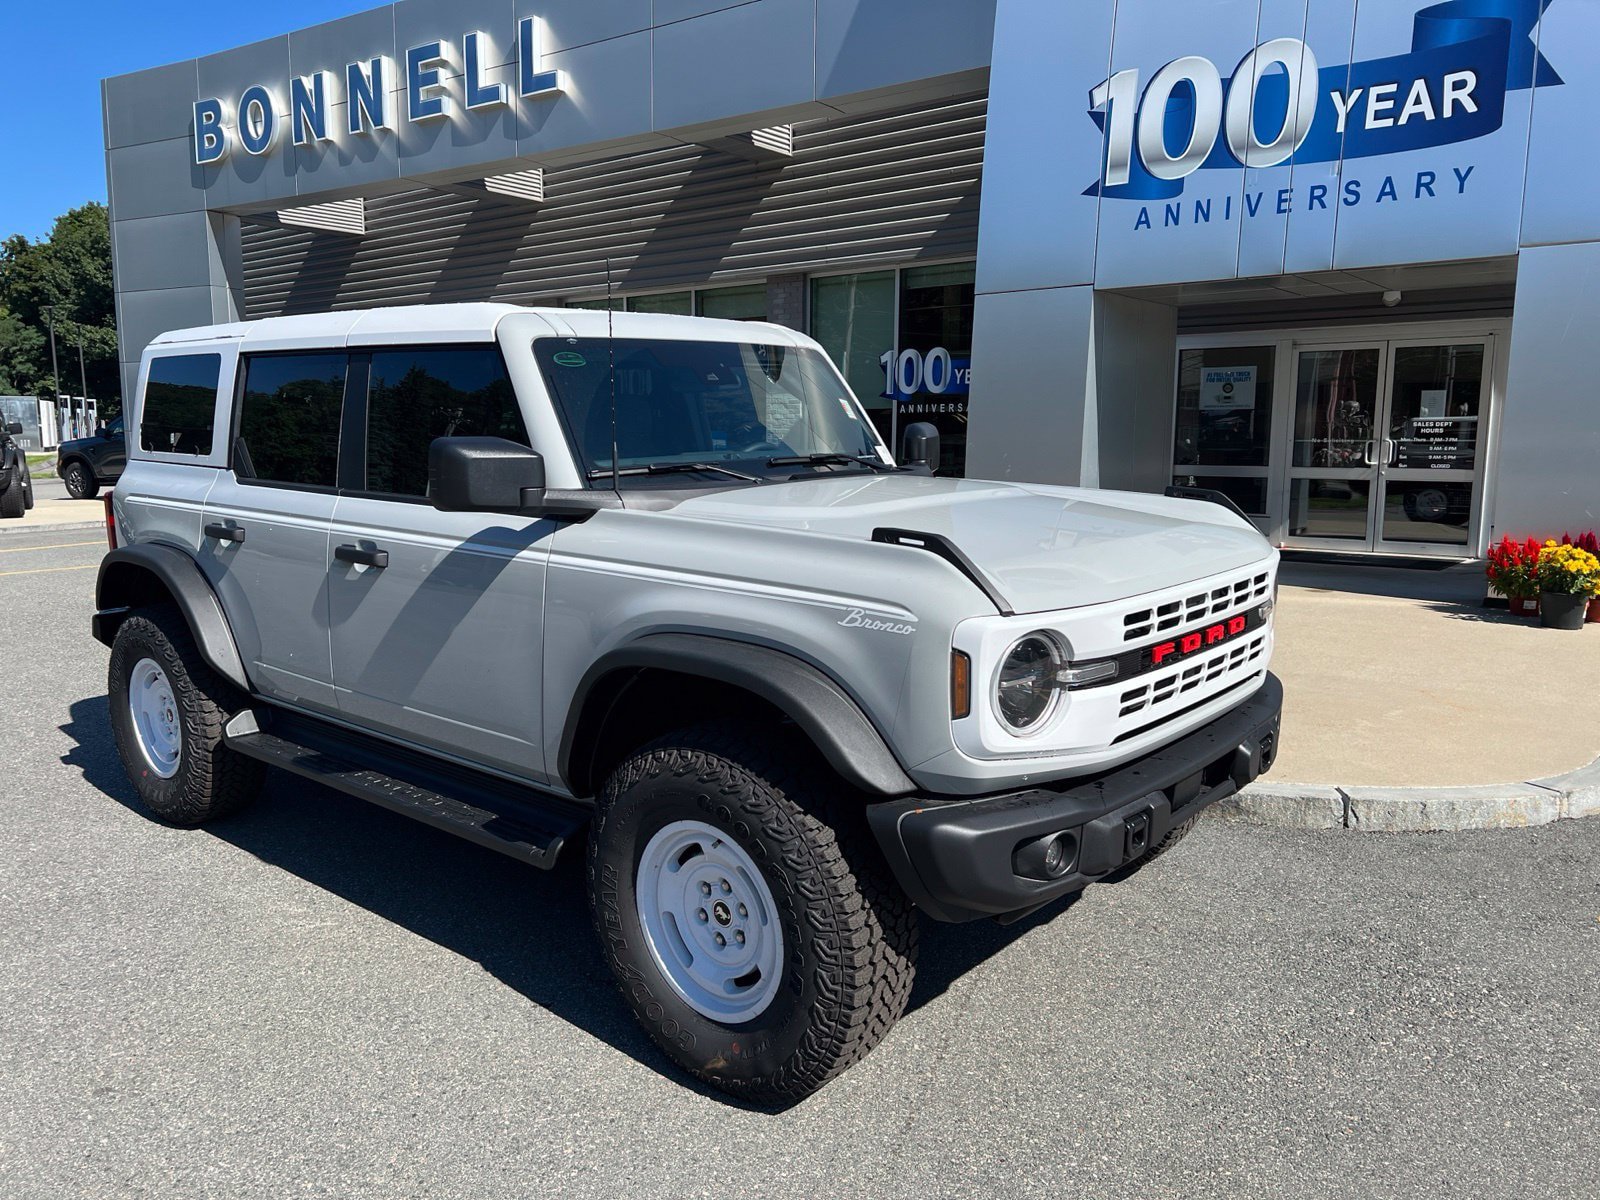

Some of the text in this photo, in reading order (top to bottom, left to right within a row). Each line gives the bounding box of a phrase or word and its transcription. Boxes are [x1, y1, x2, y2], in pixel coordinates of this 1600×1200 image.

[193, 15, 565, 164] BONNELL
[1091, 37, 1478, 187] 100 YEAR
[1134, 165, 1476, 231] ANNIVERSARY
[880, 346, 952, 395] 100
[837, 607, 917, 635] Bronco
[1152, 615, 1246, 664] FORD
